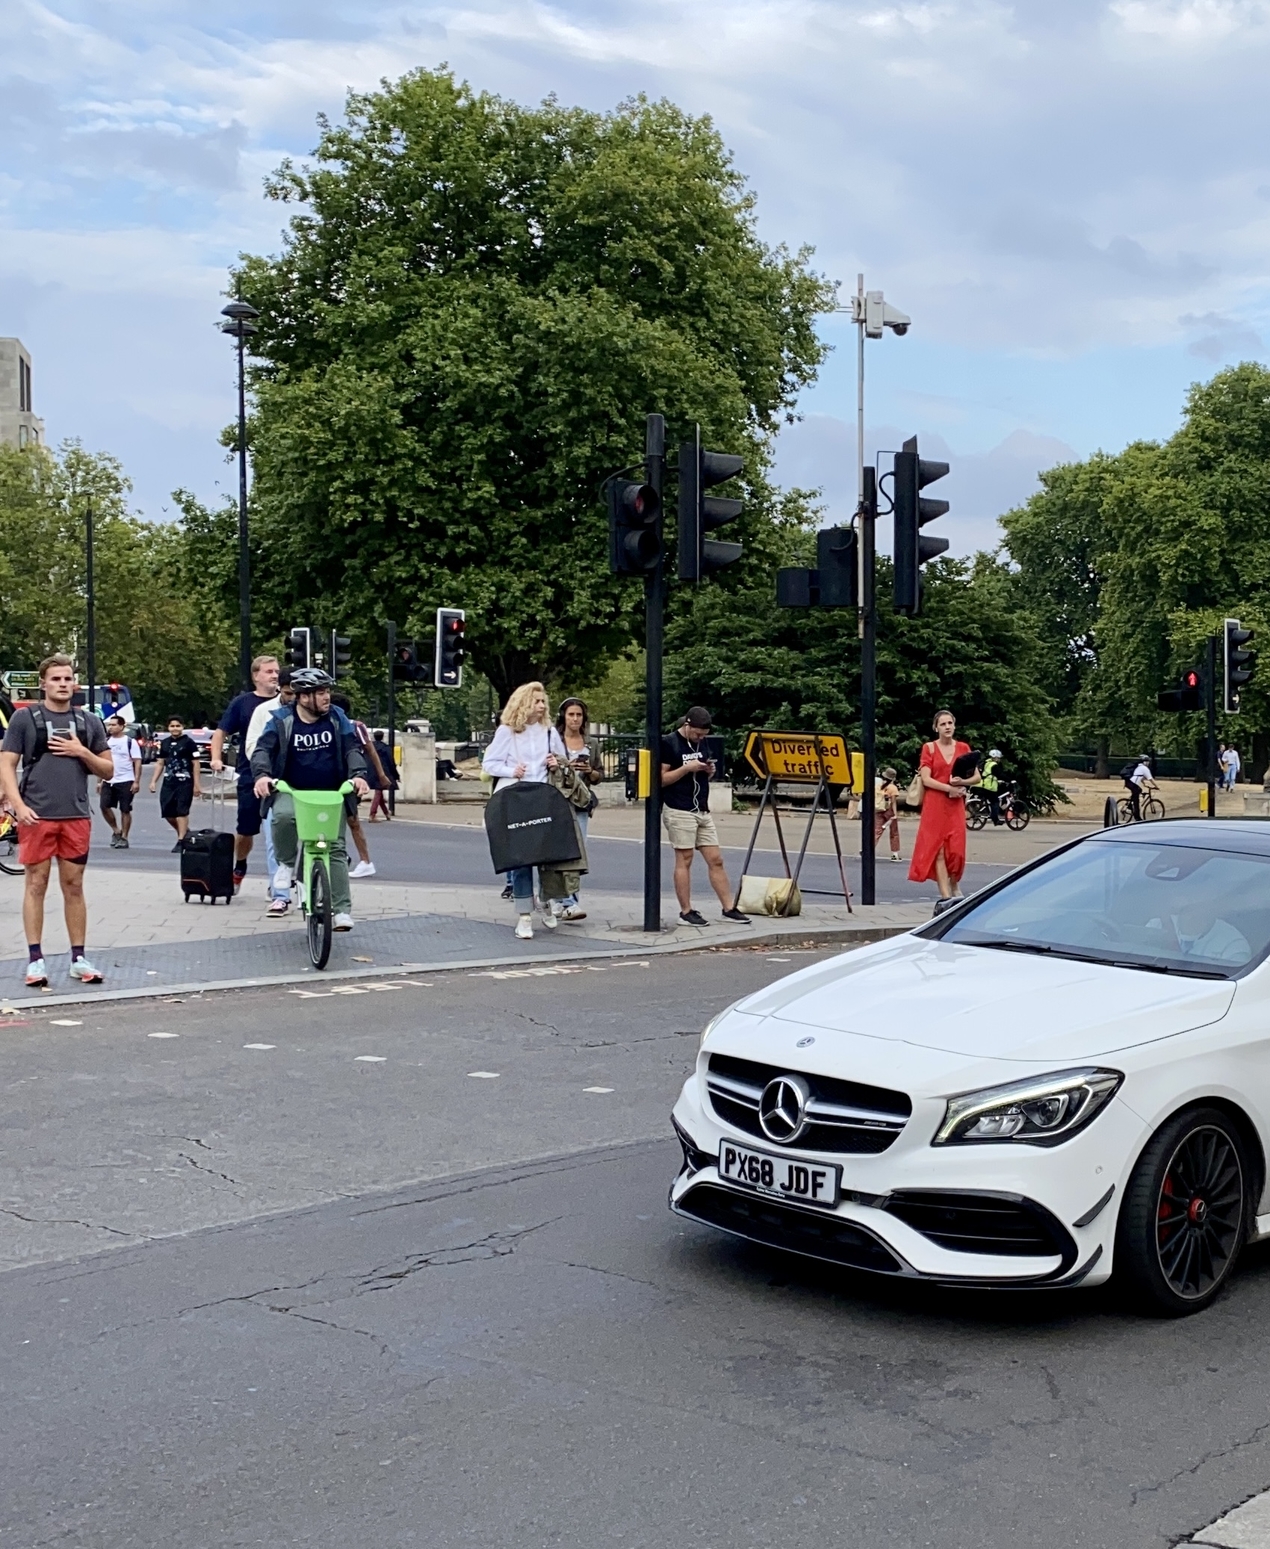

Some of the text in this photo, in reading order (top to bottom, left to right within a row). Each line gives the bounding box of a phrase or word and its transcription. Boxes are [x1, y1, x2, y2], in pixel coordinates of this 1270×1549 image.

[293, 730, 332, 747] POLO
[783, 759, 834, 775] traffc
[507, 816, 553, 830] NET-A-PORTER
[725, 1147, 826, 1198] PX68 JDF
